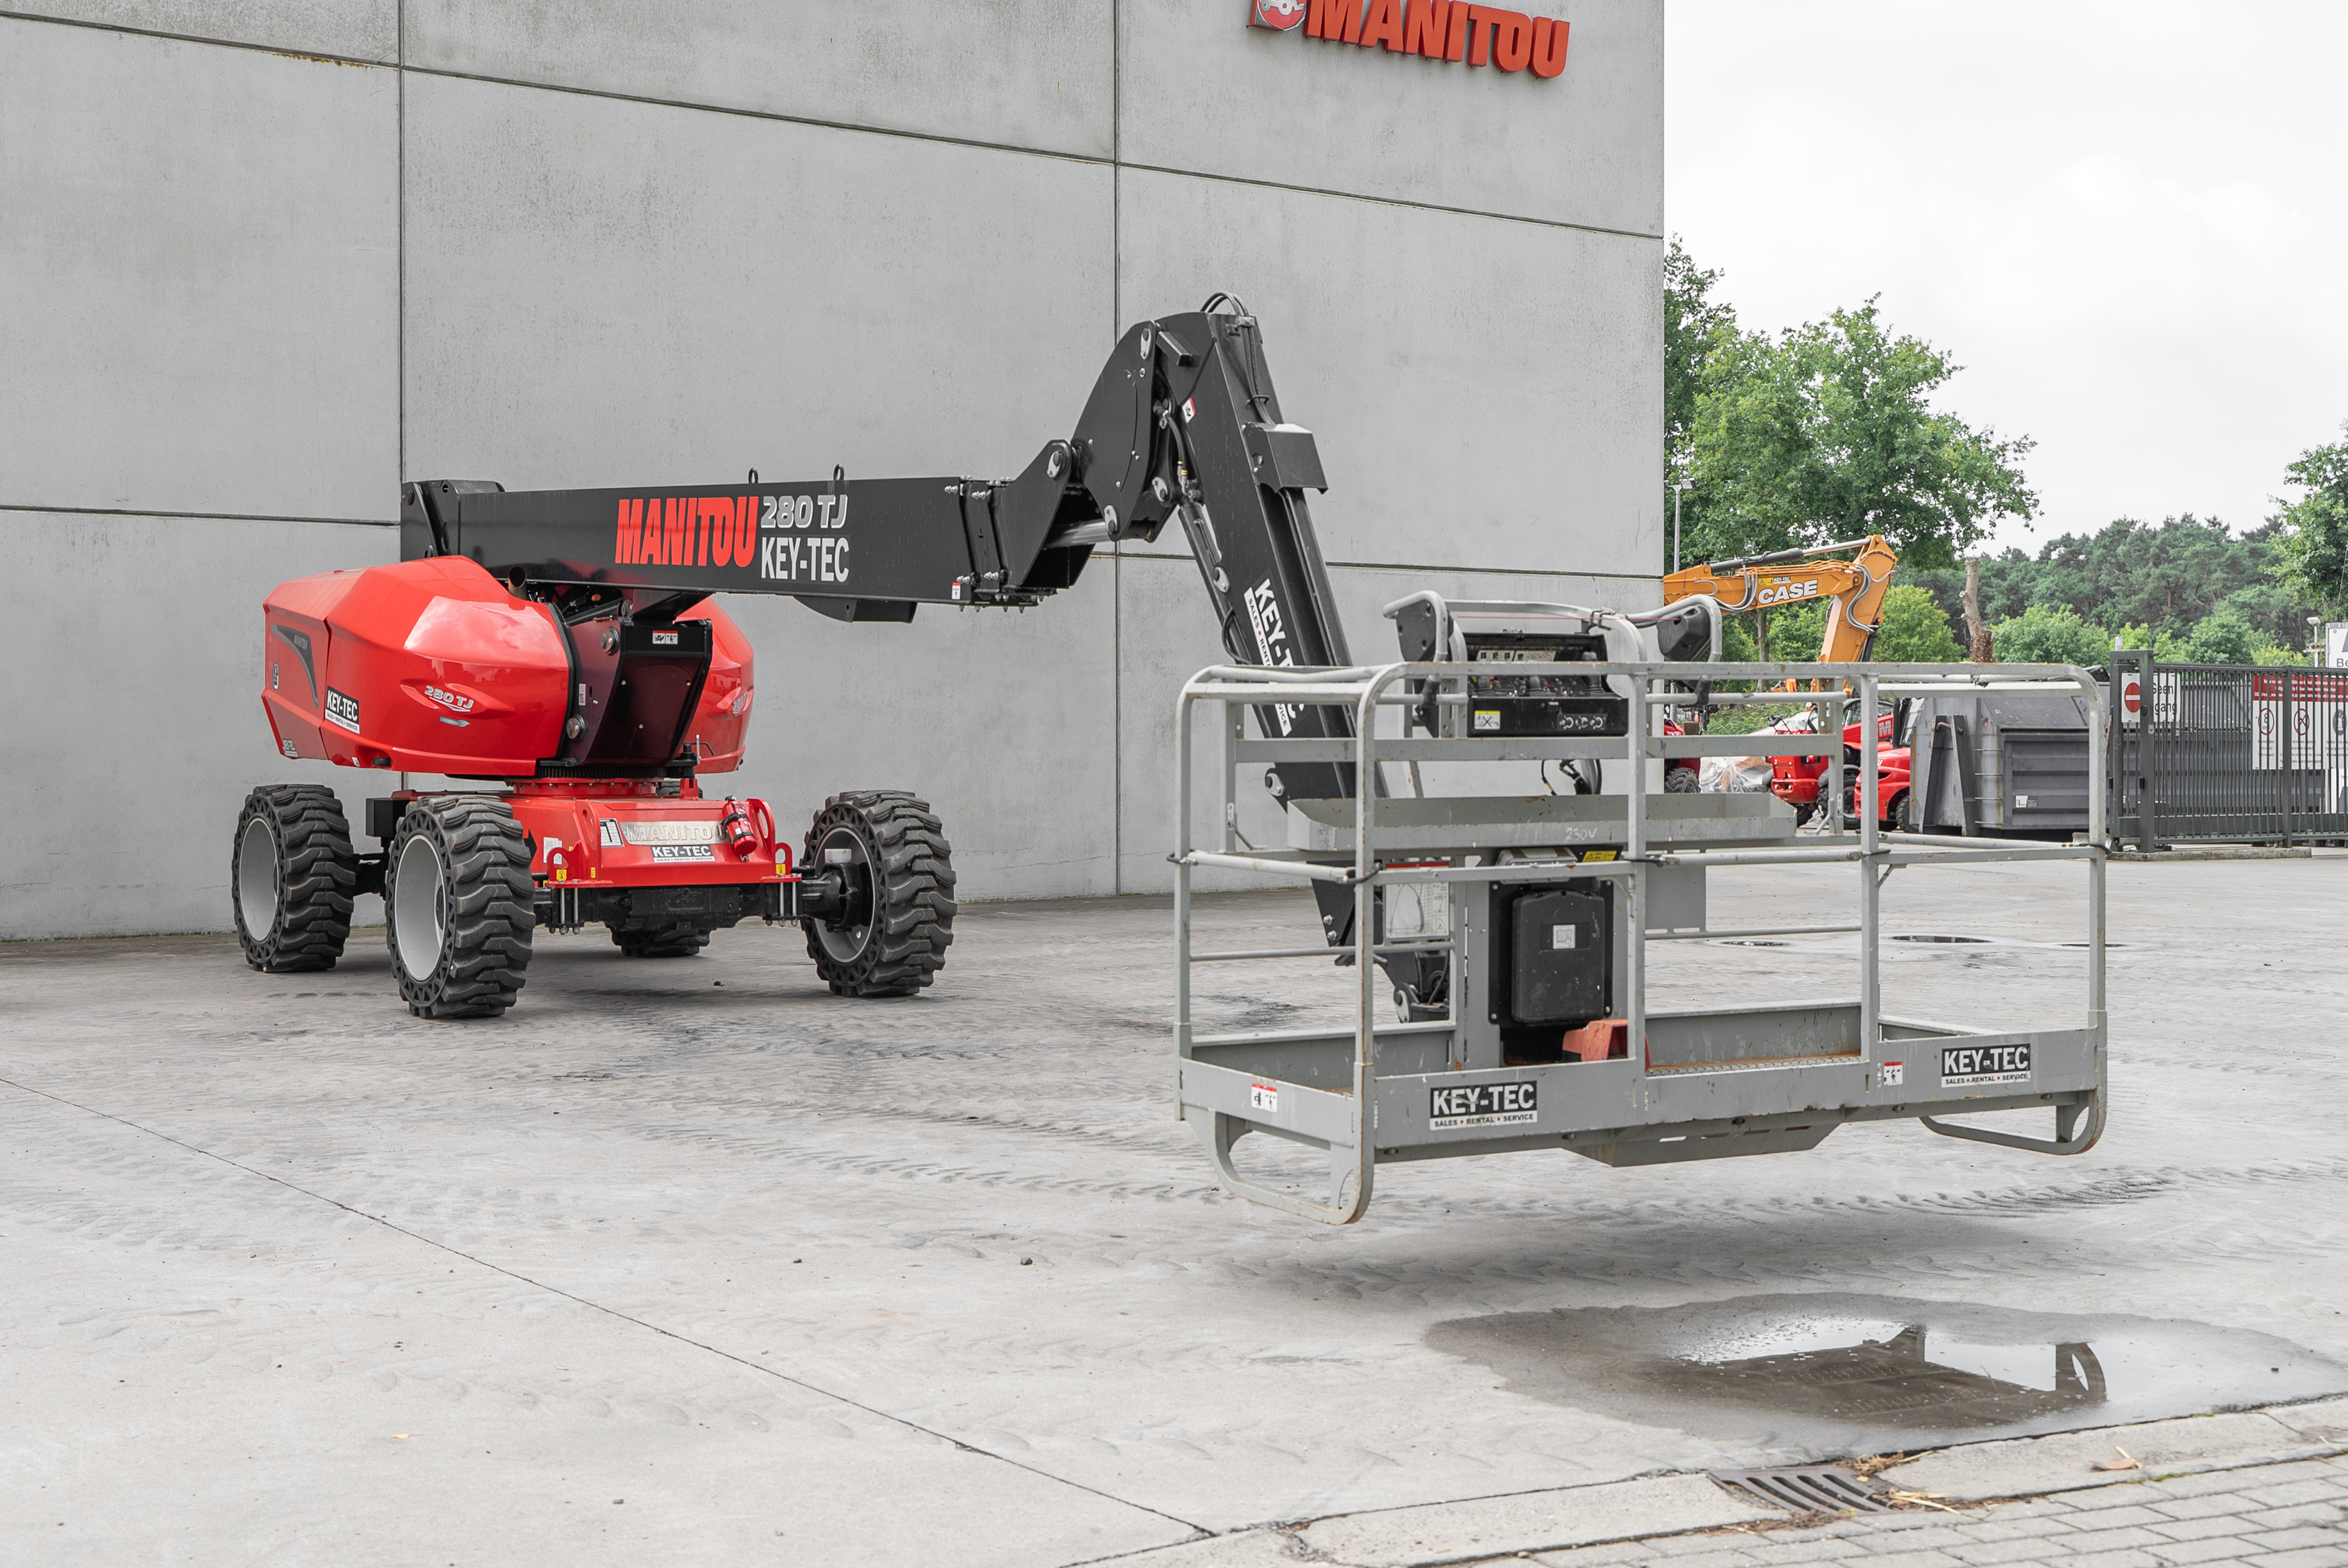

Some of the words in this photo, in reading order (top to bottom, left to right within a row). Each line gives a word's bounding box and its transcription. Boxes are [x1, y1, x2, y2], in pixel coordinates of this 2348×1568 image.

[1303, 0, 1570, 79] MANITOU
[761, 495, 813, 528] 280
[817, 494, 848, 528] TJ
[615, 497, 759, 567] MANITOU
[761, 537, 849, 582] KEY-TEC
[1758, 579, 1818, 605] CASE
[1249, 598, 1259, 629] SALES
[327, 689, 358, 721] KEY-TEC
[424, 684, 454, 703] 280
[456, 695, 474, 709] TJ
[626, 825, 727, 841] MANITOU
[1564, 827, 1597, 841] 230V
[652, 845, 711, 857] KEY-TEC
[1944, 1046, 2029, 1074] KEY-TEC
[1433, 1084, 1534, 1116] KEY-TEC
